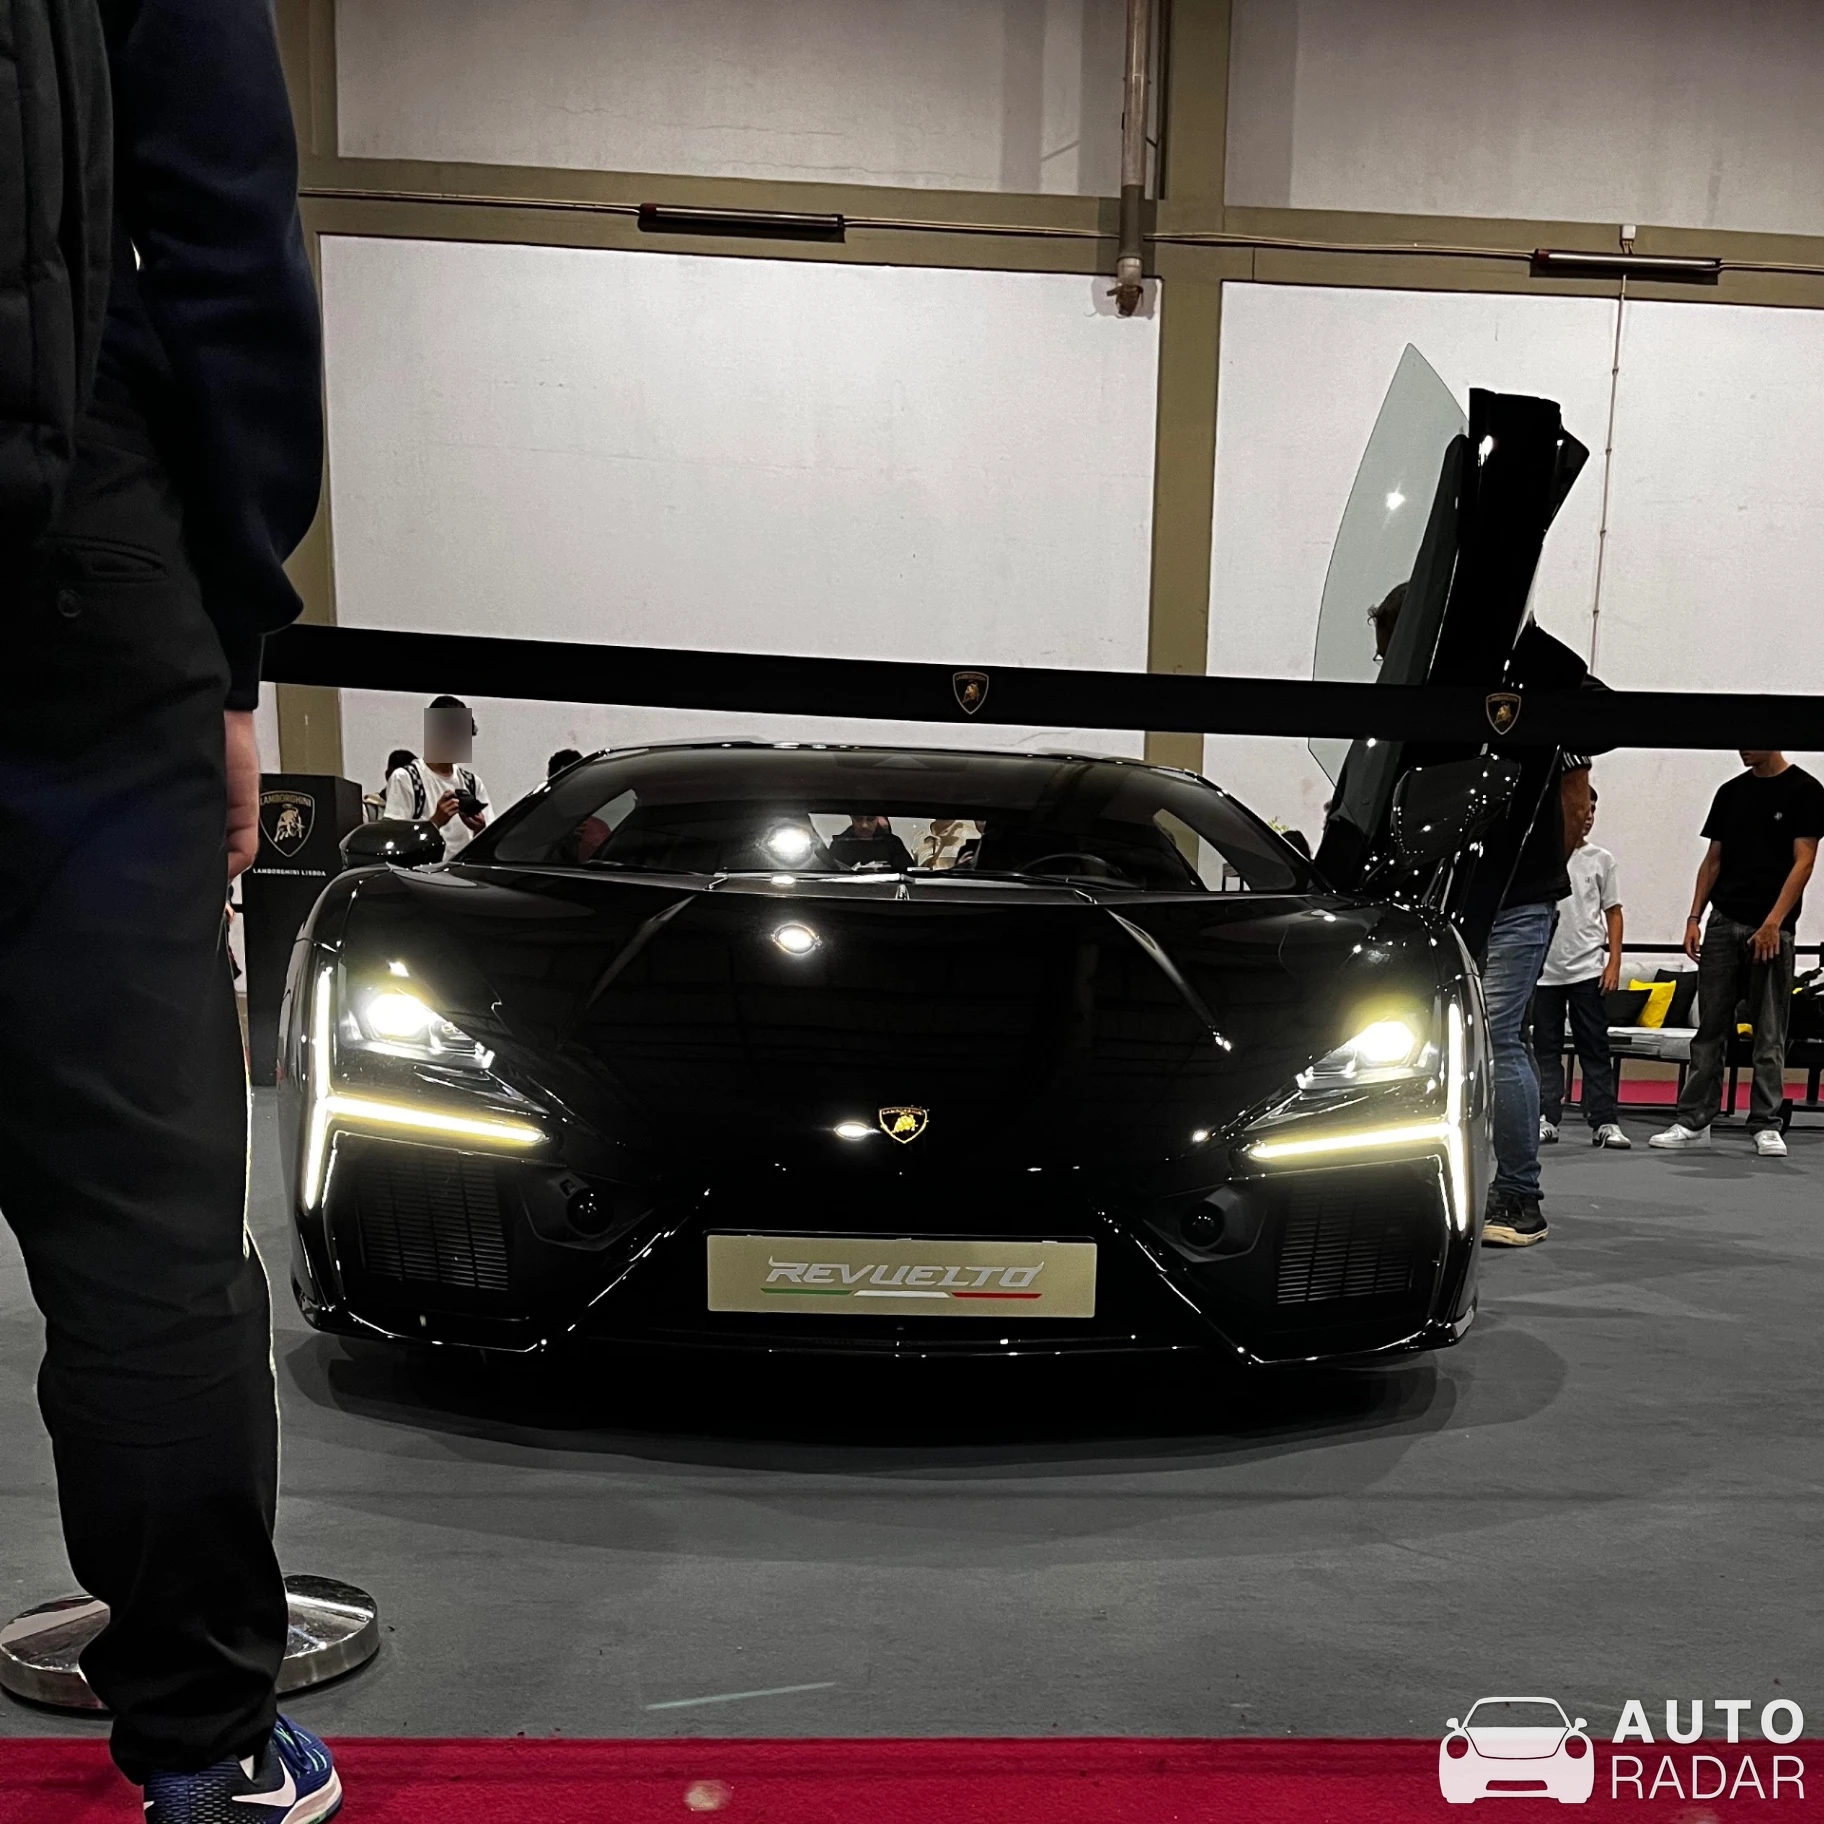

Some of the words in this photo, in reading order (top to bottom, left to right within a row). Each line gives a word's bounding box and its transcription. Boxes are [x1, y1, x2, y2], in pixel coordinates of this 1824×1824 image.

[253, 868, 300, 876] LAMBORGHINI
[301, 869, 326, 877] LISBOA
[765, 1256, 1045, 1288] REVUELTO
